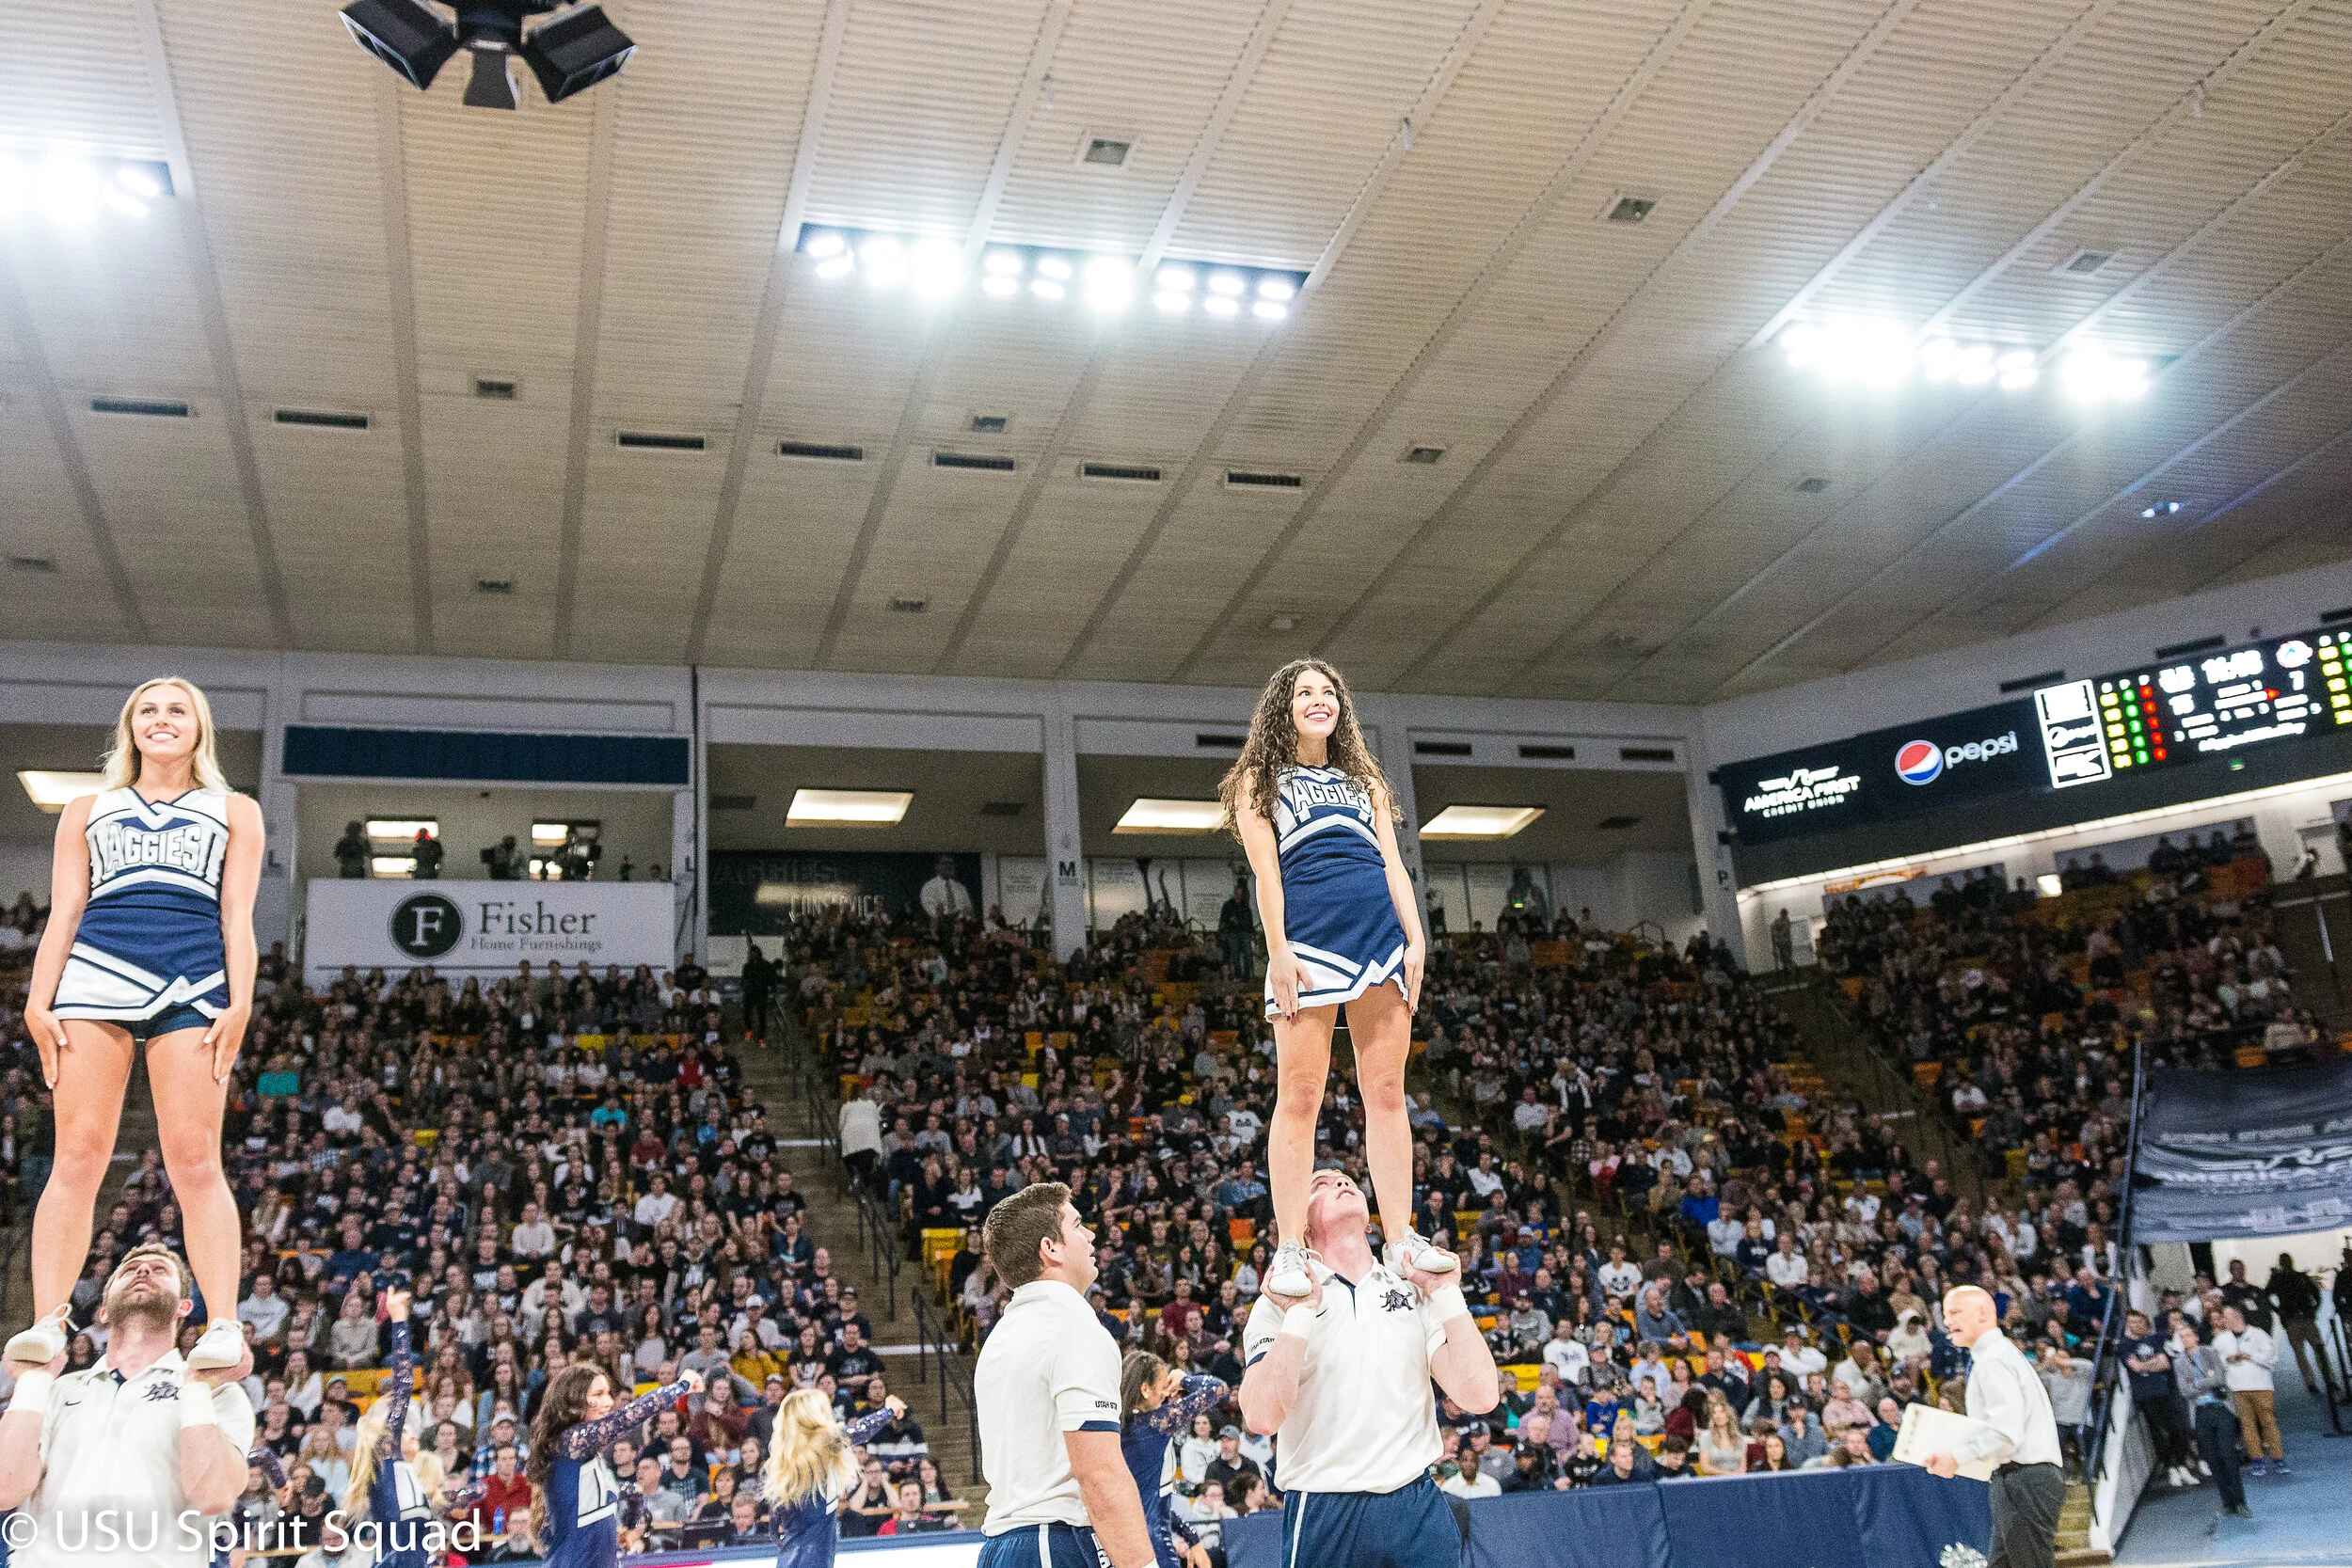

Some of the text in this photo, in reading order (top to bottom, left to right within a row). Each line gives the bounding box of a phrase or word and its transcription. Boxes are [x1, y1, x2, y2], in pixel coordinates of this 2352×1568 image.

[1945, 731, 2018, 769] pepsi
[1291, 778, 1372, 816] AGGIES
[1743, 775, 1861, 813] AMERICA FIRST
[103, 822, 201, 874] AGGIES
[1058, 861, 1075, 877] M
[1717, 869, 1729, 886] P
[409, 906, 445, 946] F
[478, 900, 599, 935] Fisher
[471, 937, 604, 953] Home Furnishings
[1094, 1401, 1110, 1409] UTAH
